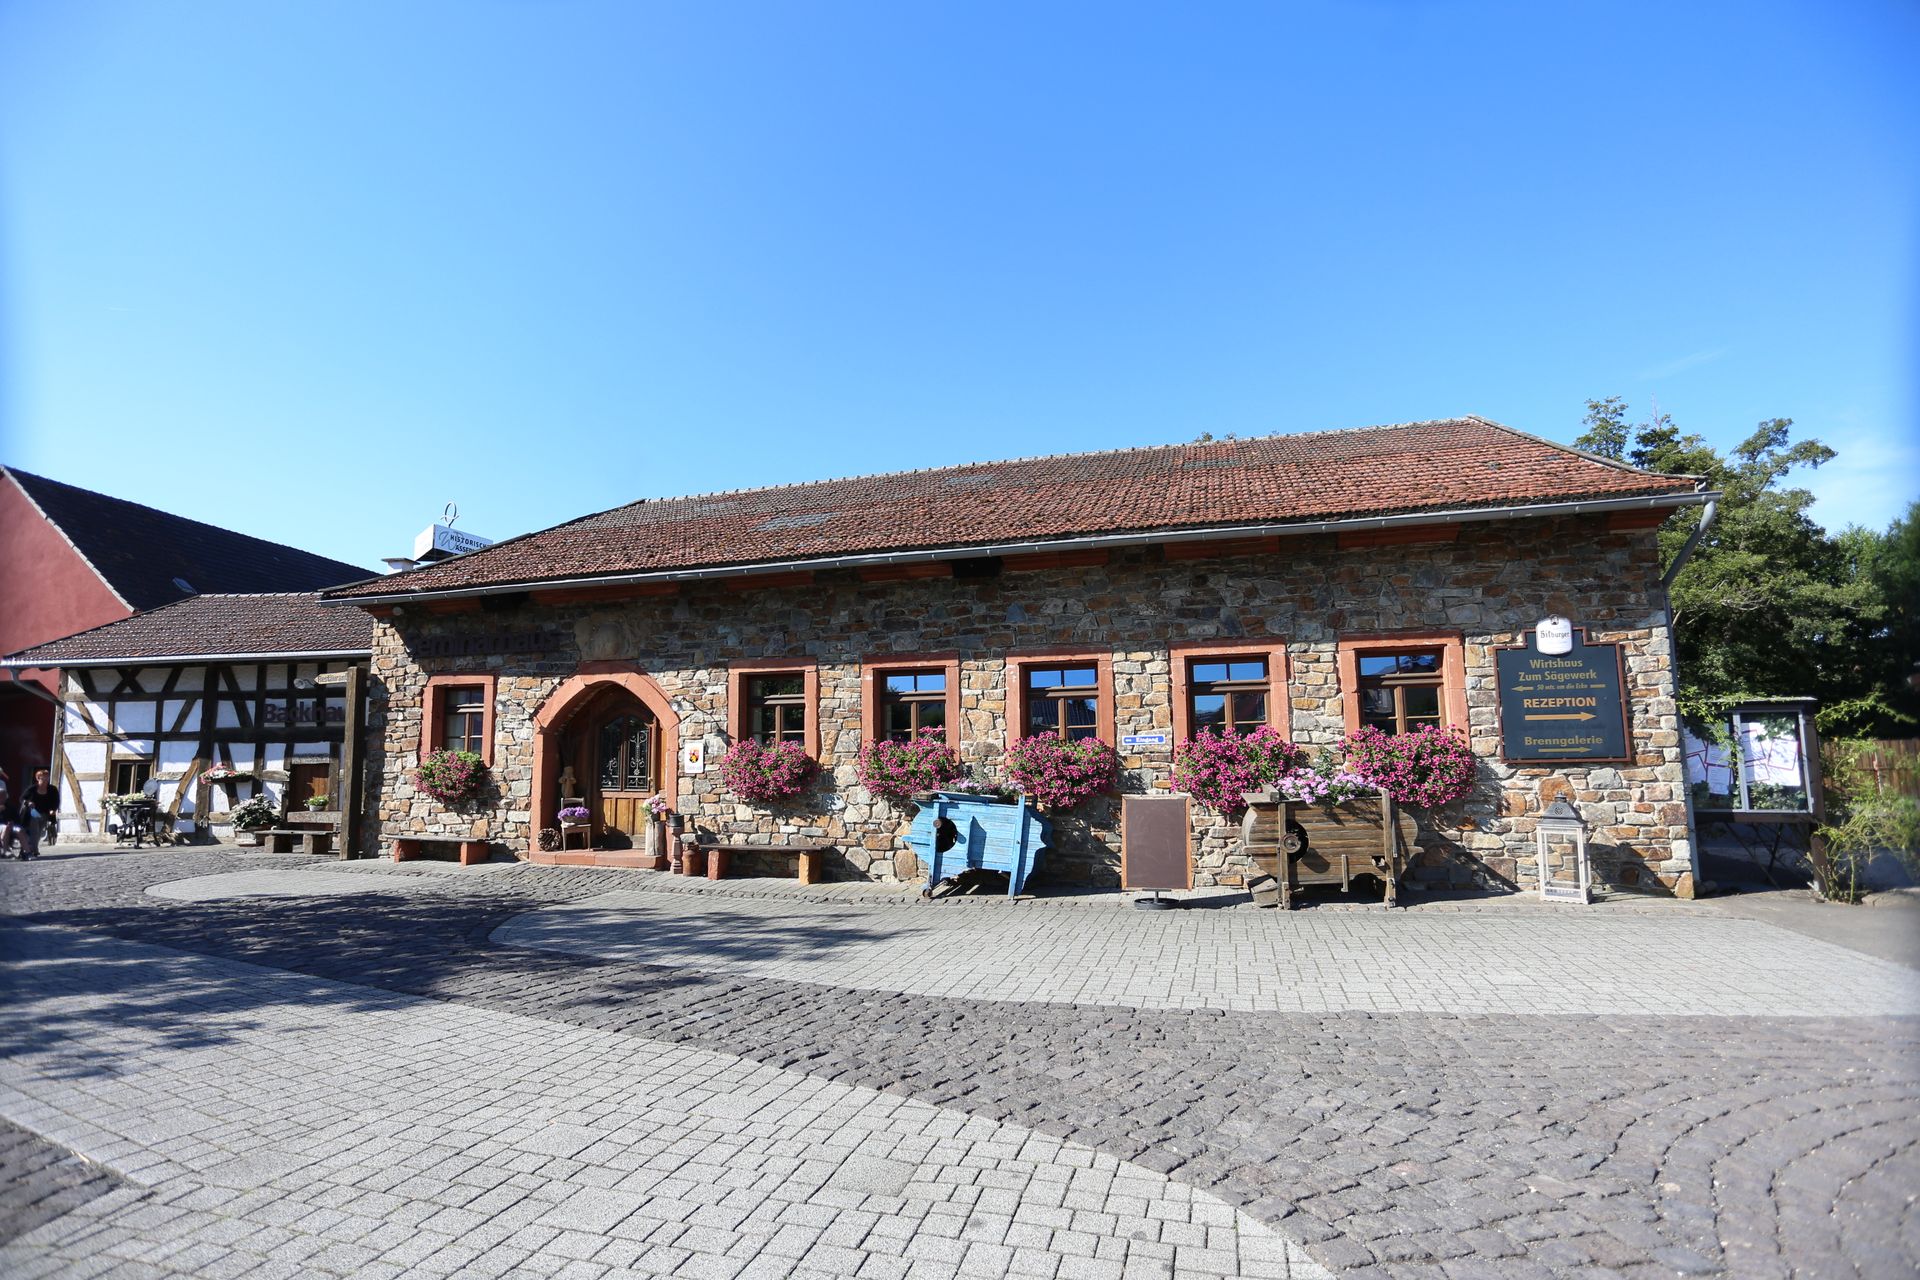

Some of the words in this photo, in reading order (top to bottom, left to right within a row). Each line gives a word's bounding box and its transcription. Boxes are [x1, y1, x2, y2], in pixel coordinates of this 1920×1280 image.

[1529, 658, 1583, 668] Wirtshaus
[1518, 672, 1542, 681] Zum
[1544, 669, 1597, 682] Sägewerk
[1523, 697, 1597, 708] REZEPTION
[1524, 736, 1604, 747] Brenngalerie
